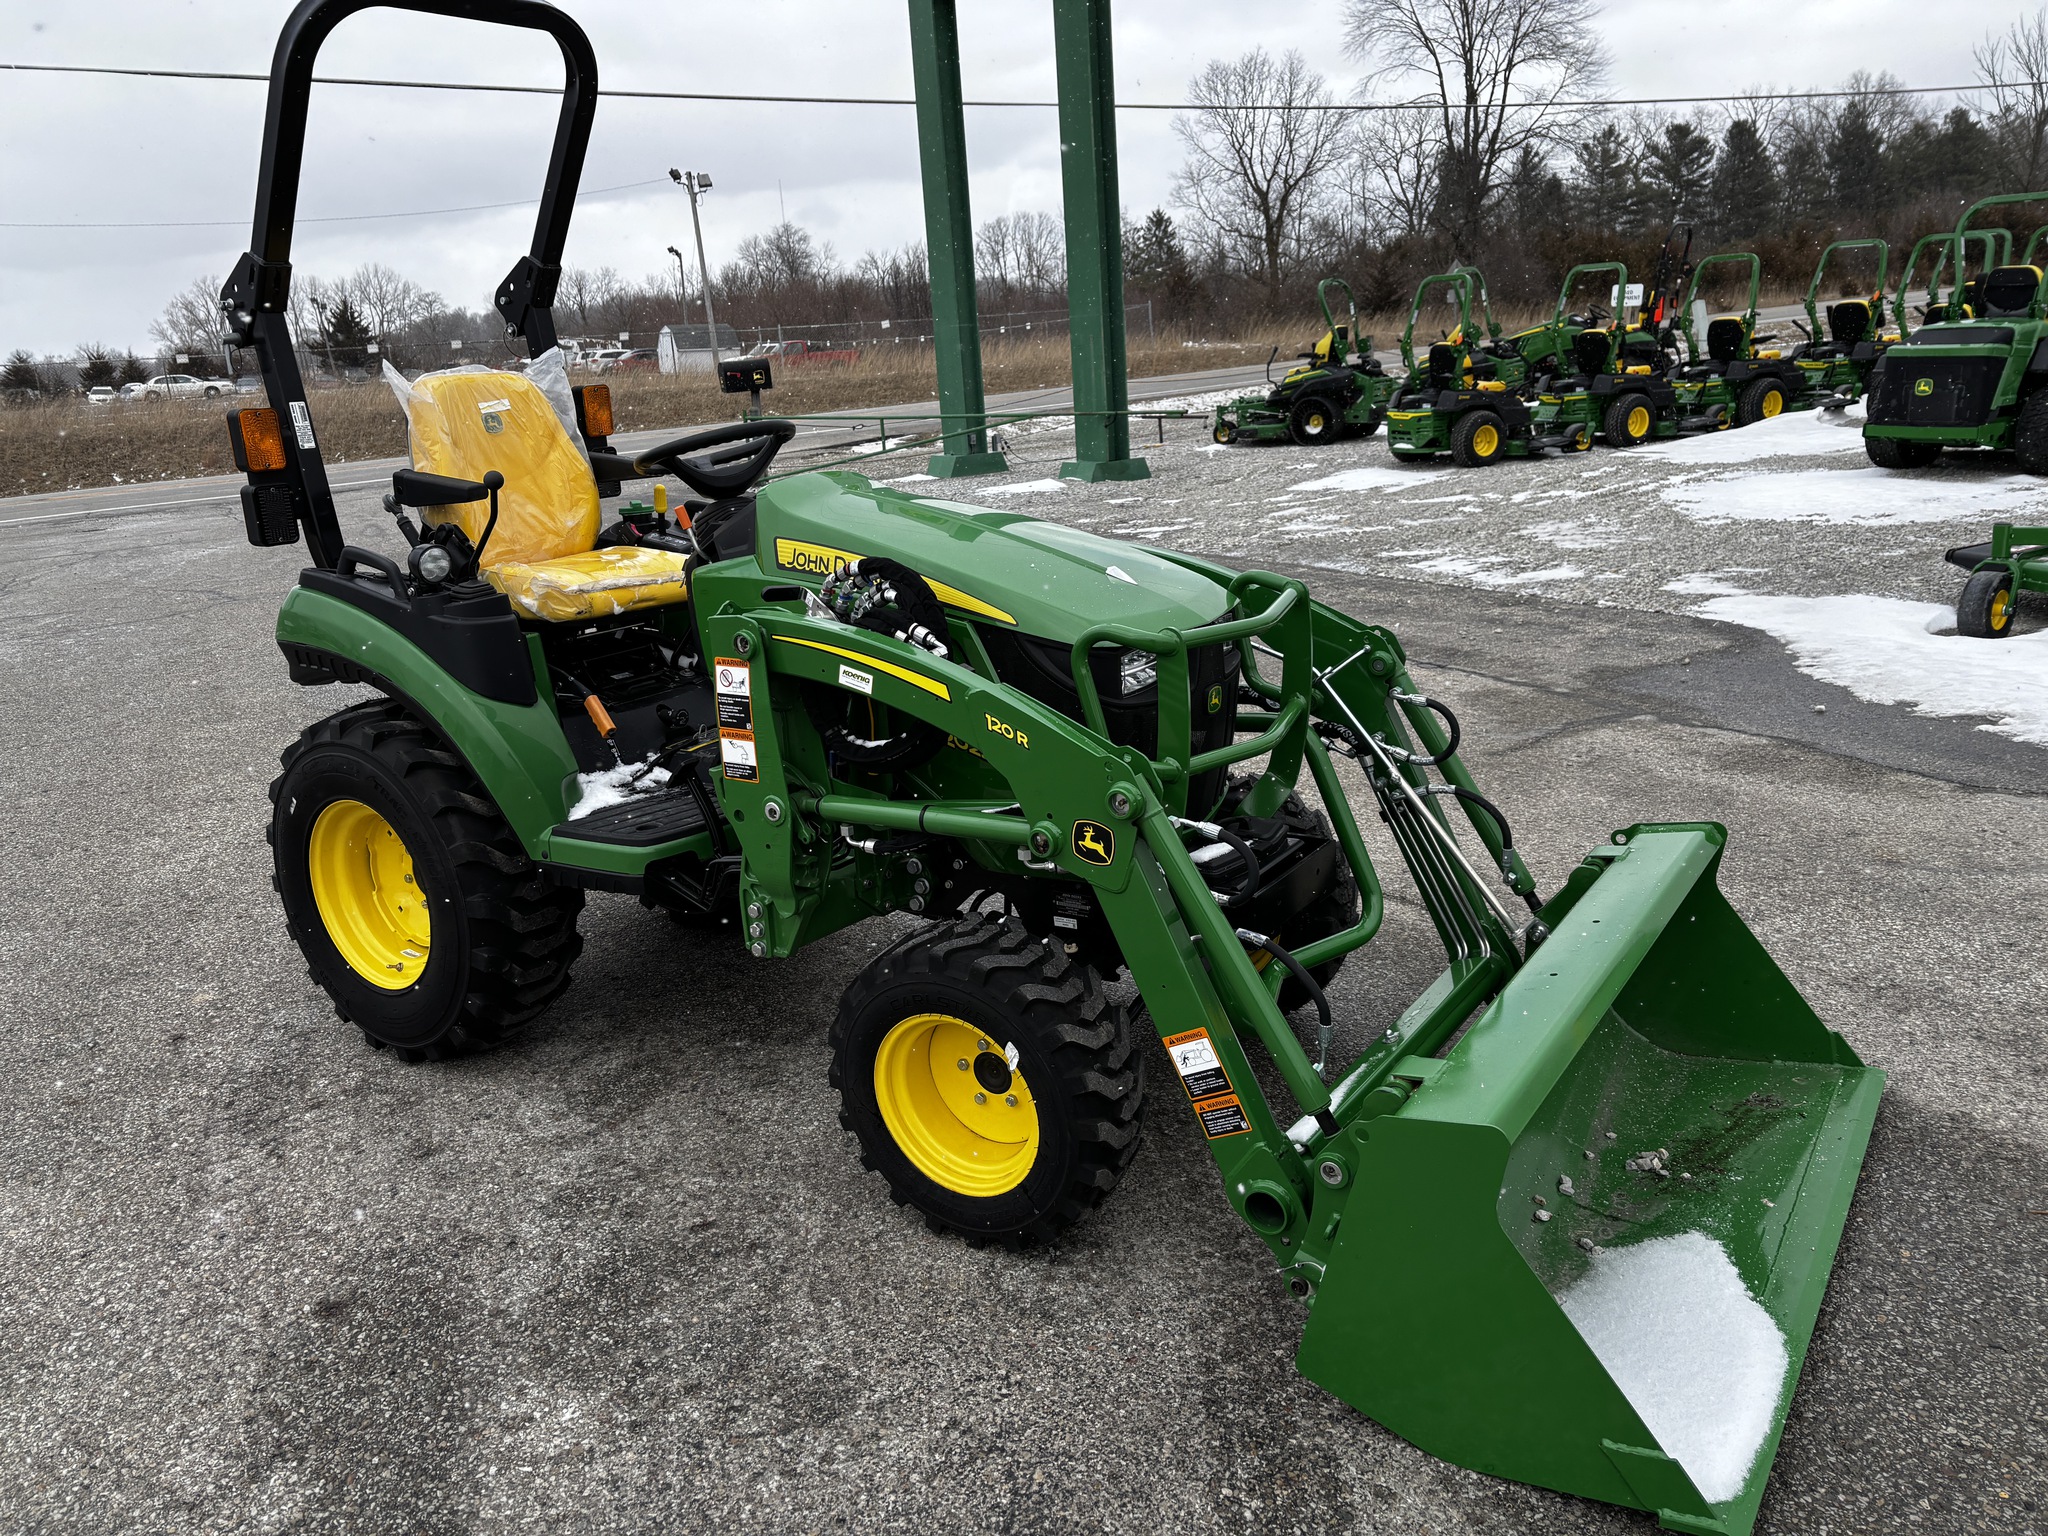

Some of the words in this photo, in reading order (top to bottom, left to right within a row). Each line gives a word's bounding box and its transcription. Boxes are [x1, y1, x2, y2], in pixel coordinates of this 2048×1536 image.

[787, 548, 830, 573] JOHN
[721, 659, 748, 668] WARNING
[726, 731, 753, 741] WARNING
[984, 712, 1014, 740] 120
[1016, 730, 1030, 749] R
[890, 994, 987, 1025] CARLSTAR
[1175, 1031, 1202, 1042] WARNING
[1206, 1097, 1235, 1109] WARNING
